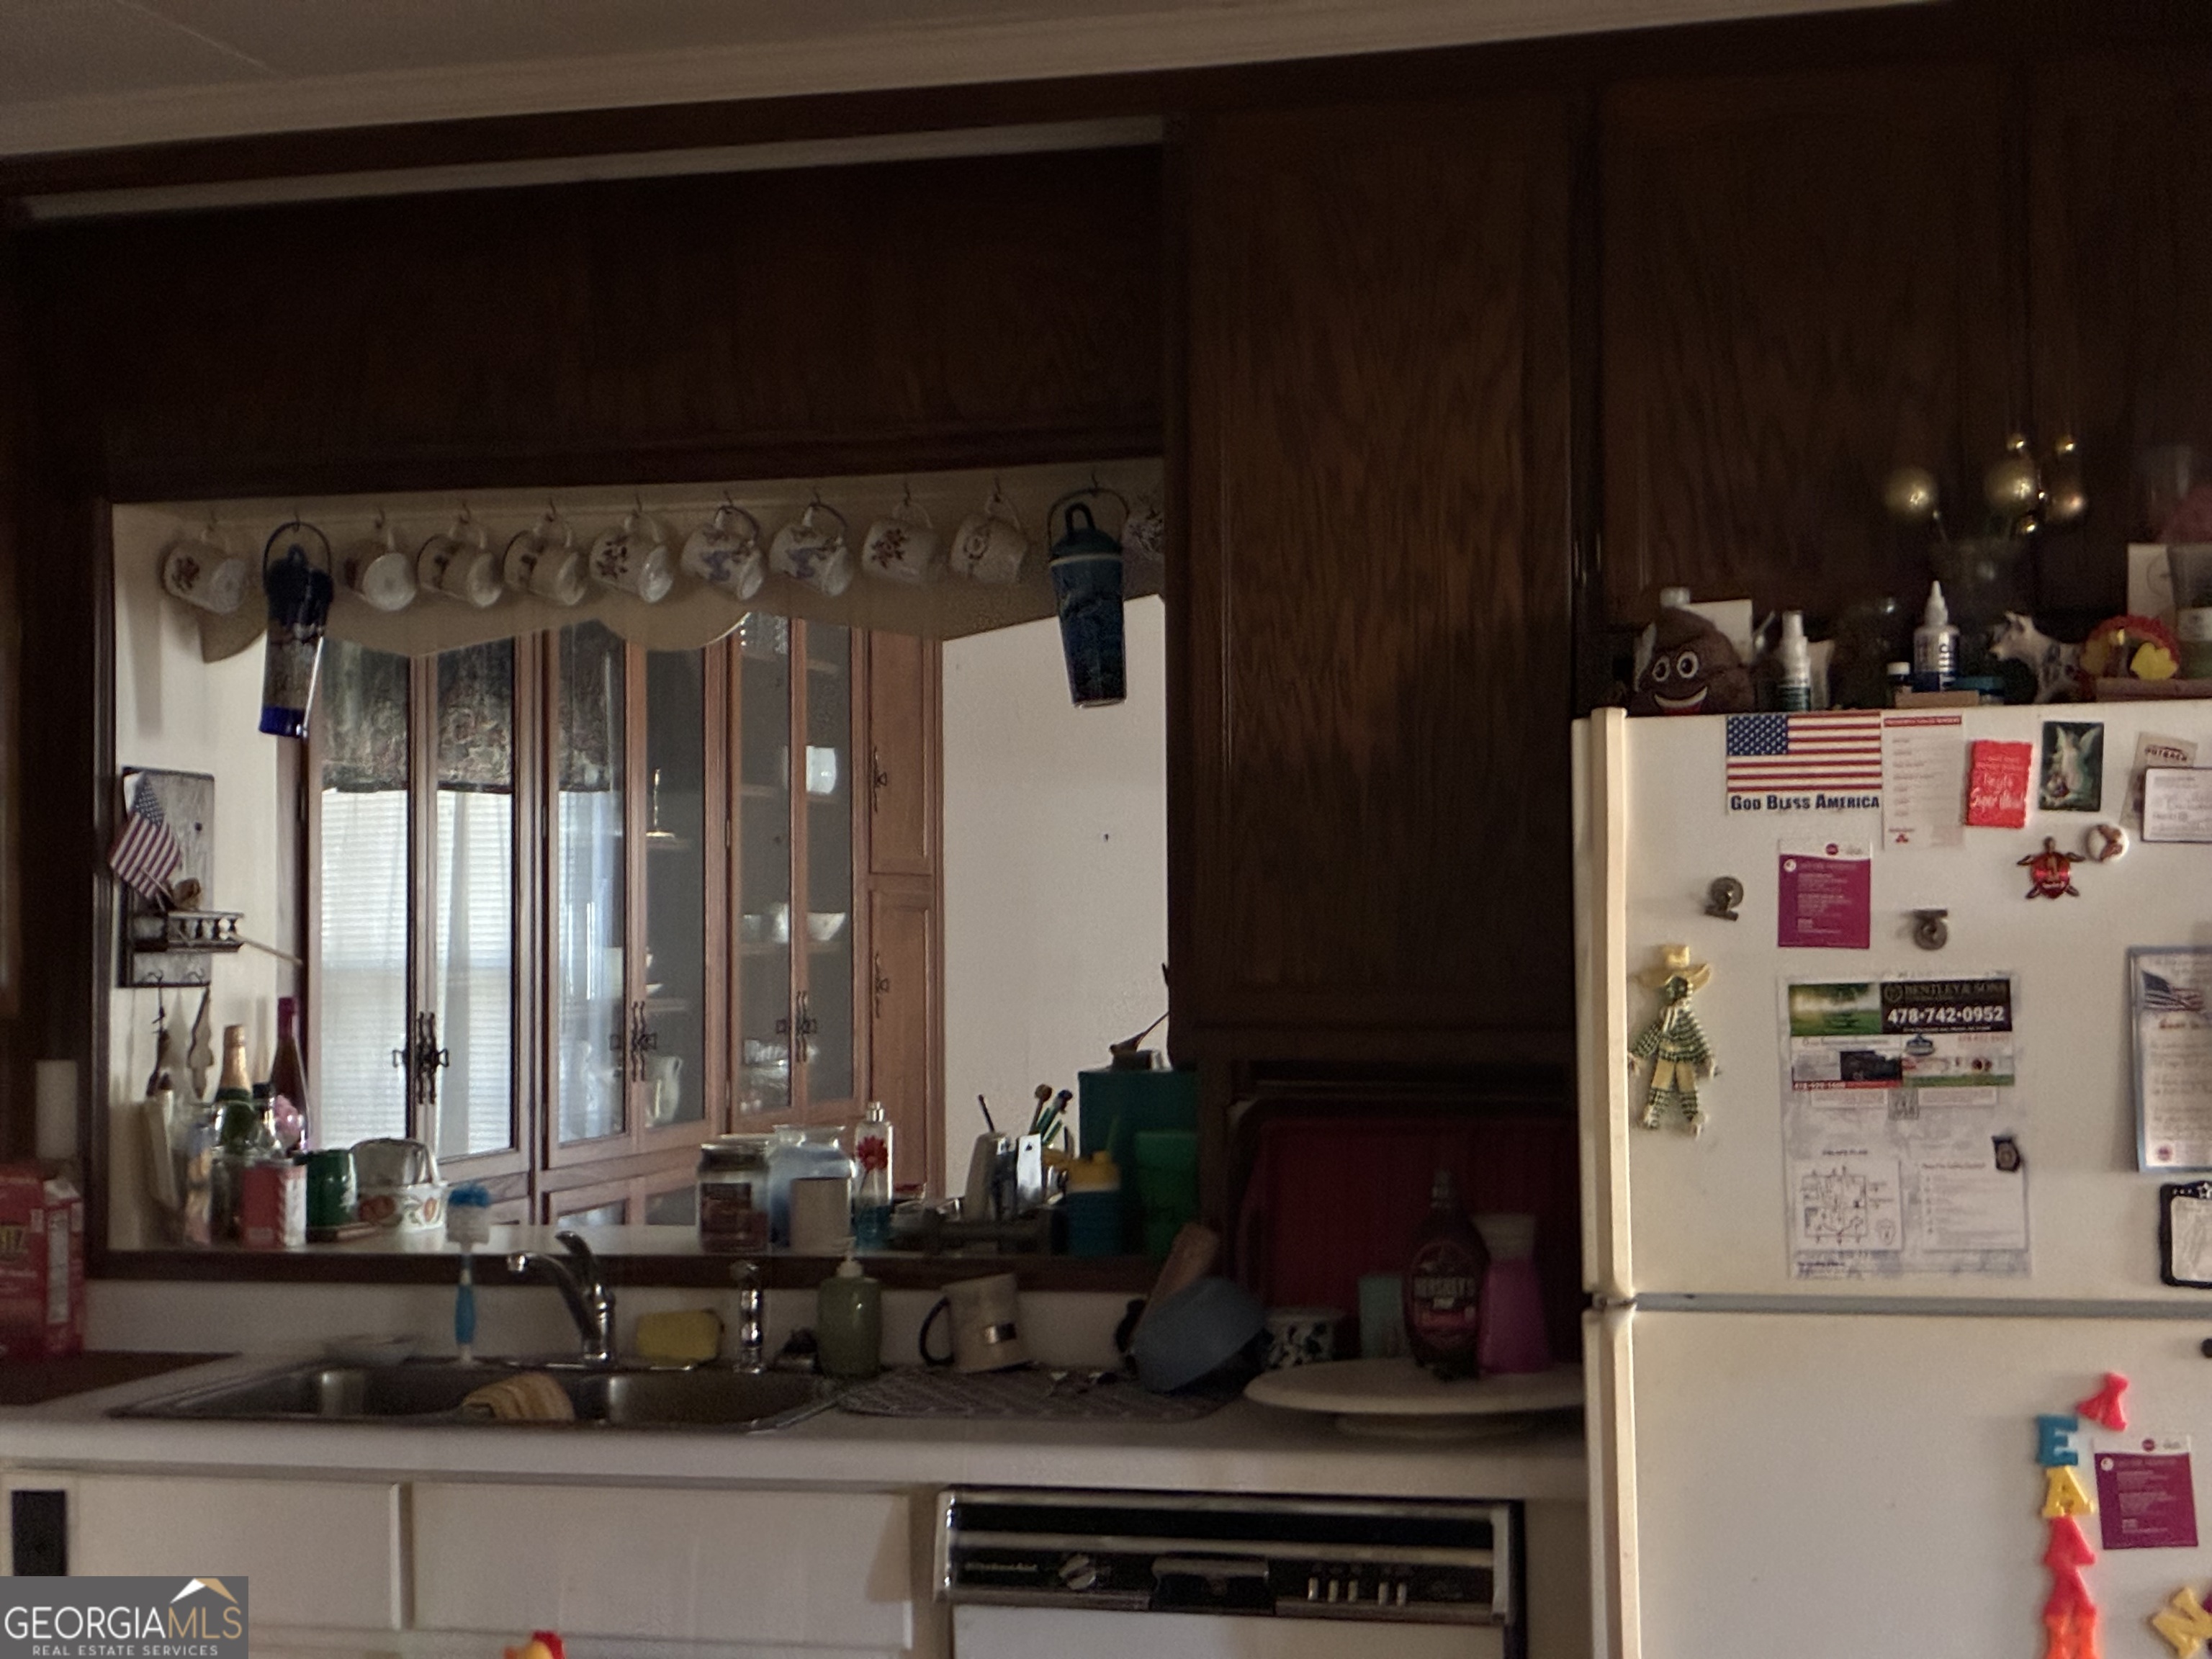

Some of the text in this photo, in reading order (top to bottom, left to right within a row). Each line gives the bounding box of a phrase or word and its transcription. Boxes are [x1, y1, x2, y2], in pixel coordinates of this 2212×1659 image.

[1731, 793, 1879, 810] GOD BLESS AMERICA
[2038, 1414, 2080, 1467] E
[2042, 1466, 2094, 1519] A
